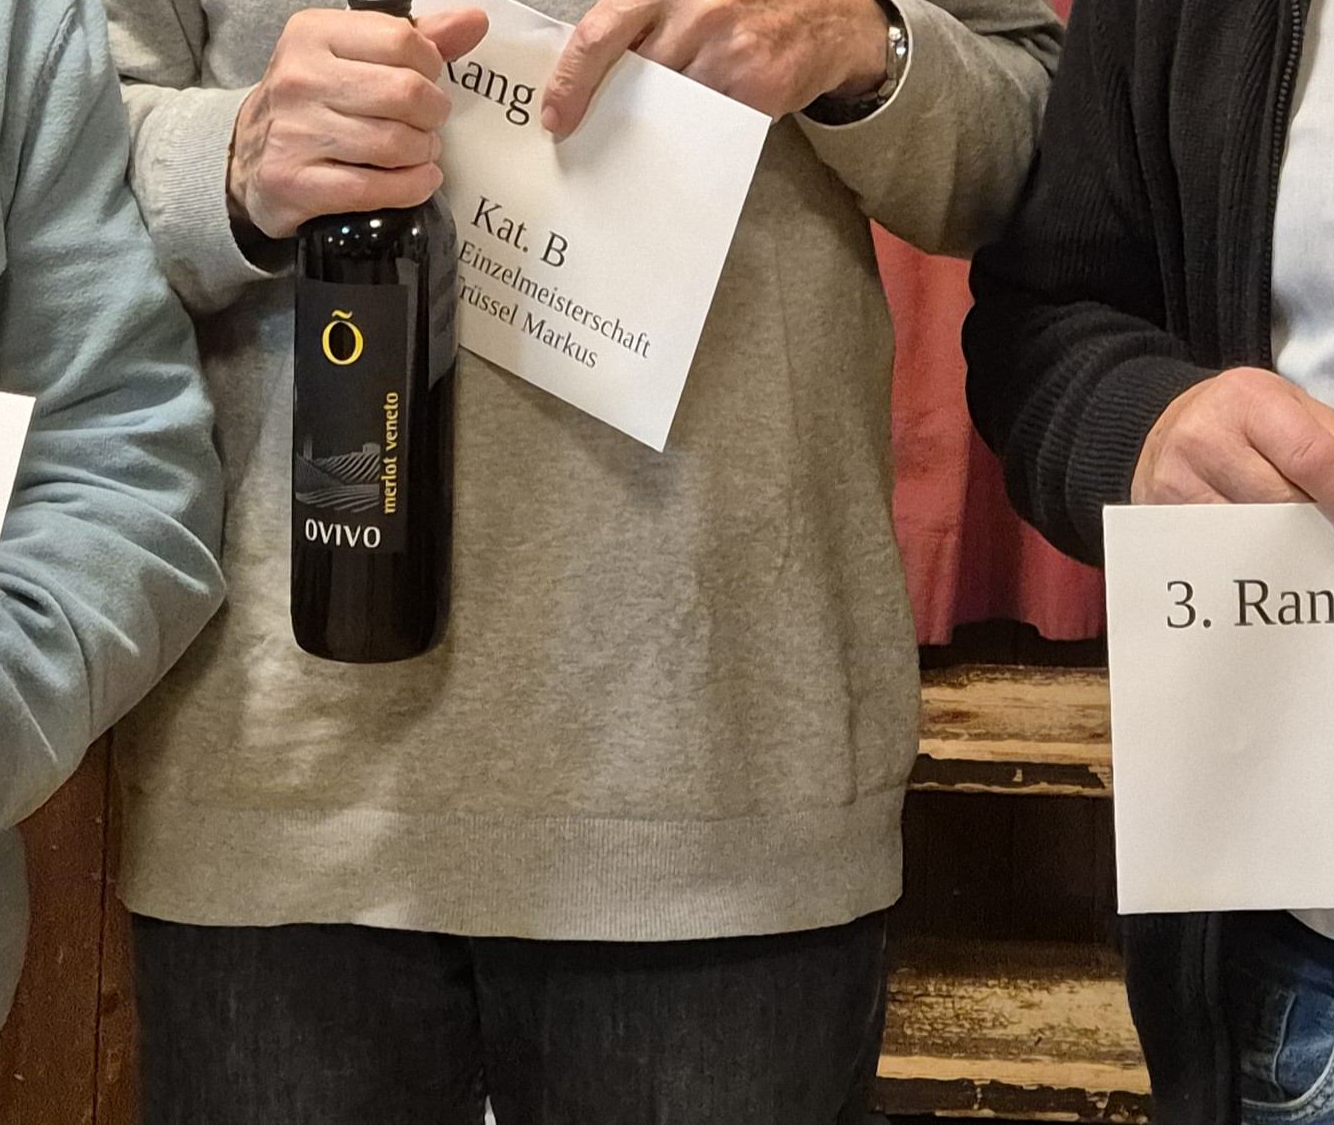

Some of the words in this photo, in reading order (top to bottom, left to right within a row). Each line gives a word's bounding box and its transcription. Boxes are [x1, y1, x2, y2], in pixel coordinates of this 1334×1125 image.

[471, 195, 529, 253] Kat.
[540, 231, 568, 268] B
[458, 240, 651, 358] Einzelmeisterschaft
[520, 312, 598, 368] Markus
[383, 391, 399, 452] veneto
[380, 456, 398, 514] merlot
[305, 518, 382, 549] OVIVO
[1166, 580, 1212, 629] 3.
